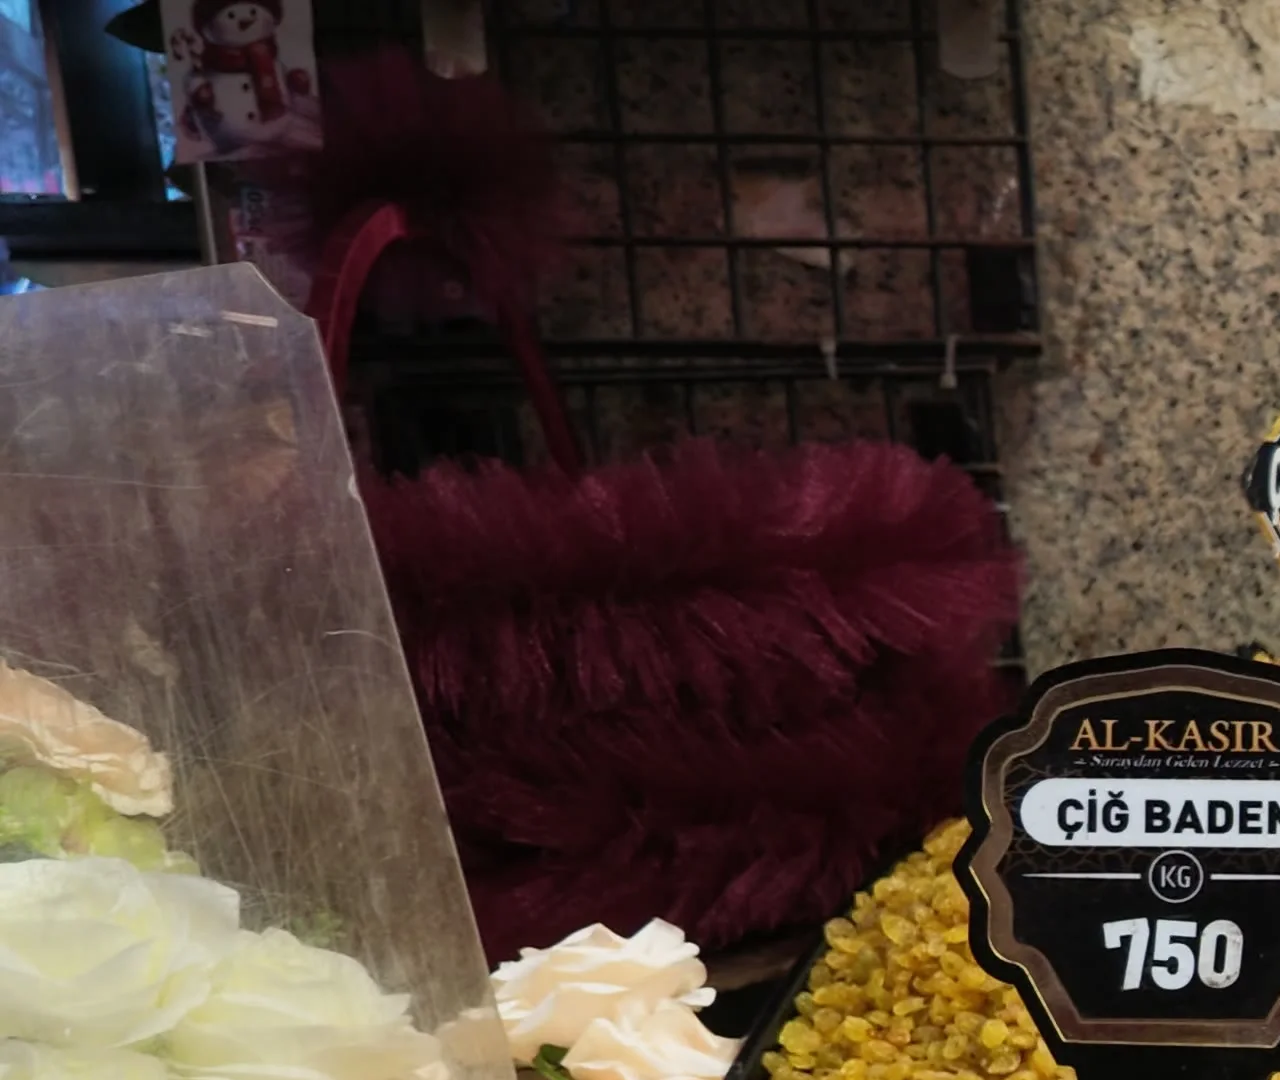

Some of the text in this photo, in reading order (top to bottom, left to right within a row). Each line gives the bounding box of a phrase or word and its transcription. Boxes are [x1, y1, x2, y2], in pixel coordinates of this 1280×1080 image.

[1069, 718, 1280, 752] AL-KASIR
[1090, 754, 1264, 771] Saraydan Gelen Lezzet
[1057, 788, 1130, 840] ÇİĞ
[1160, 867, 1191, 889] KG
[1103, 917, 1245, 991] 750
